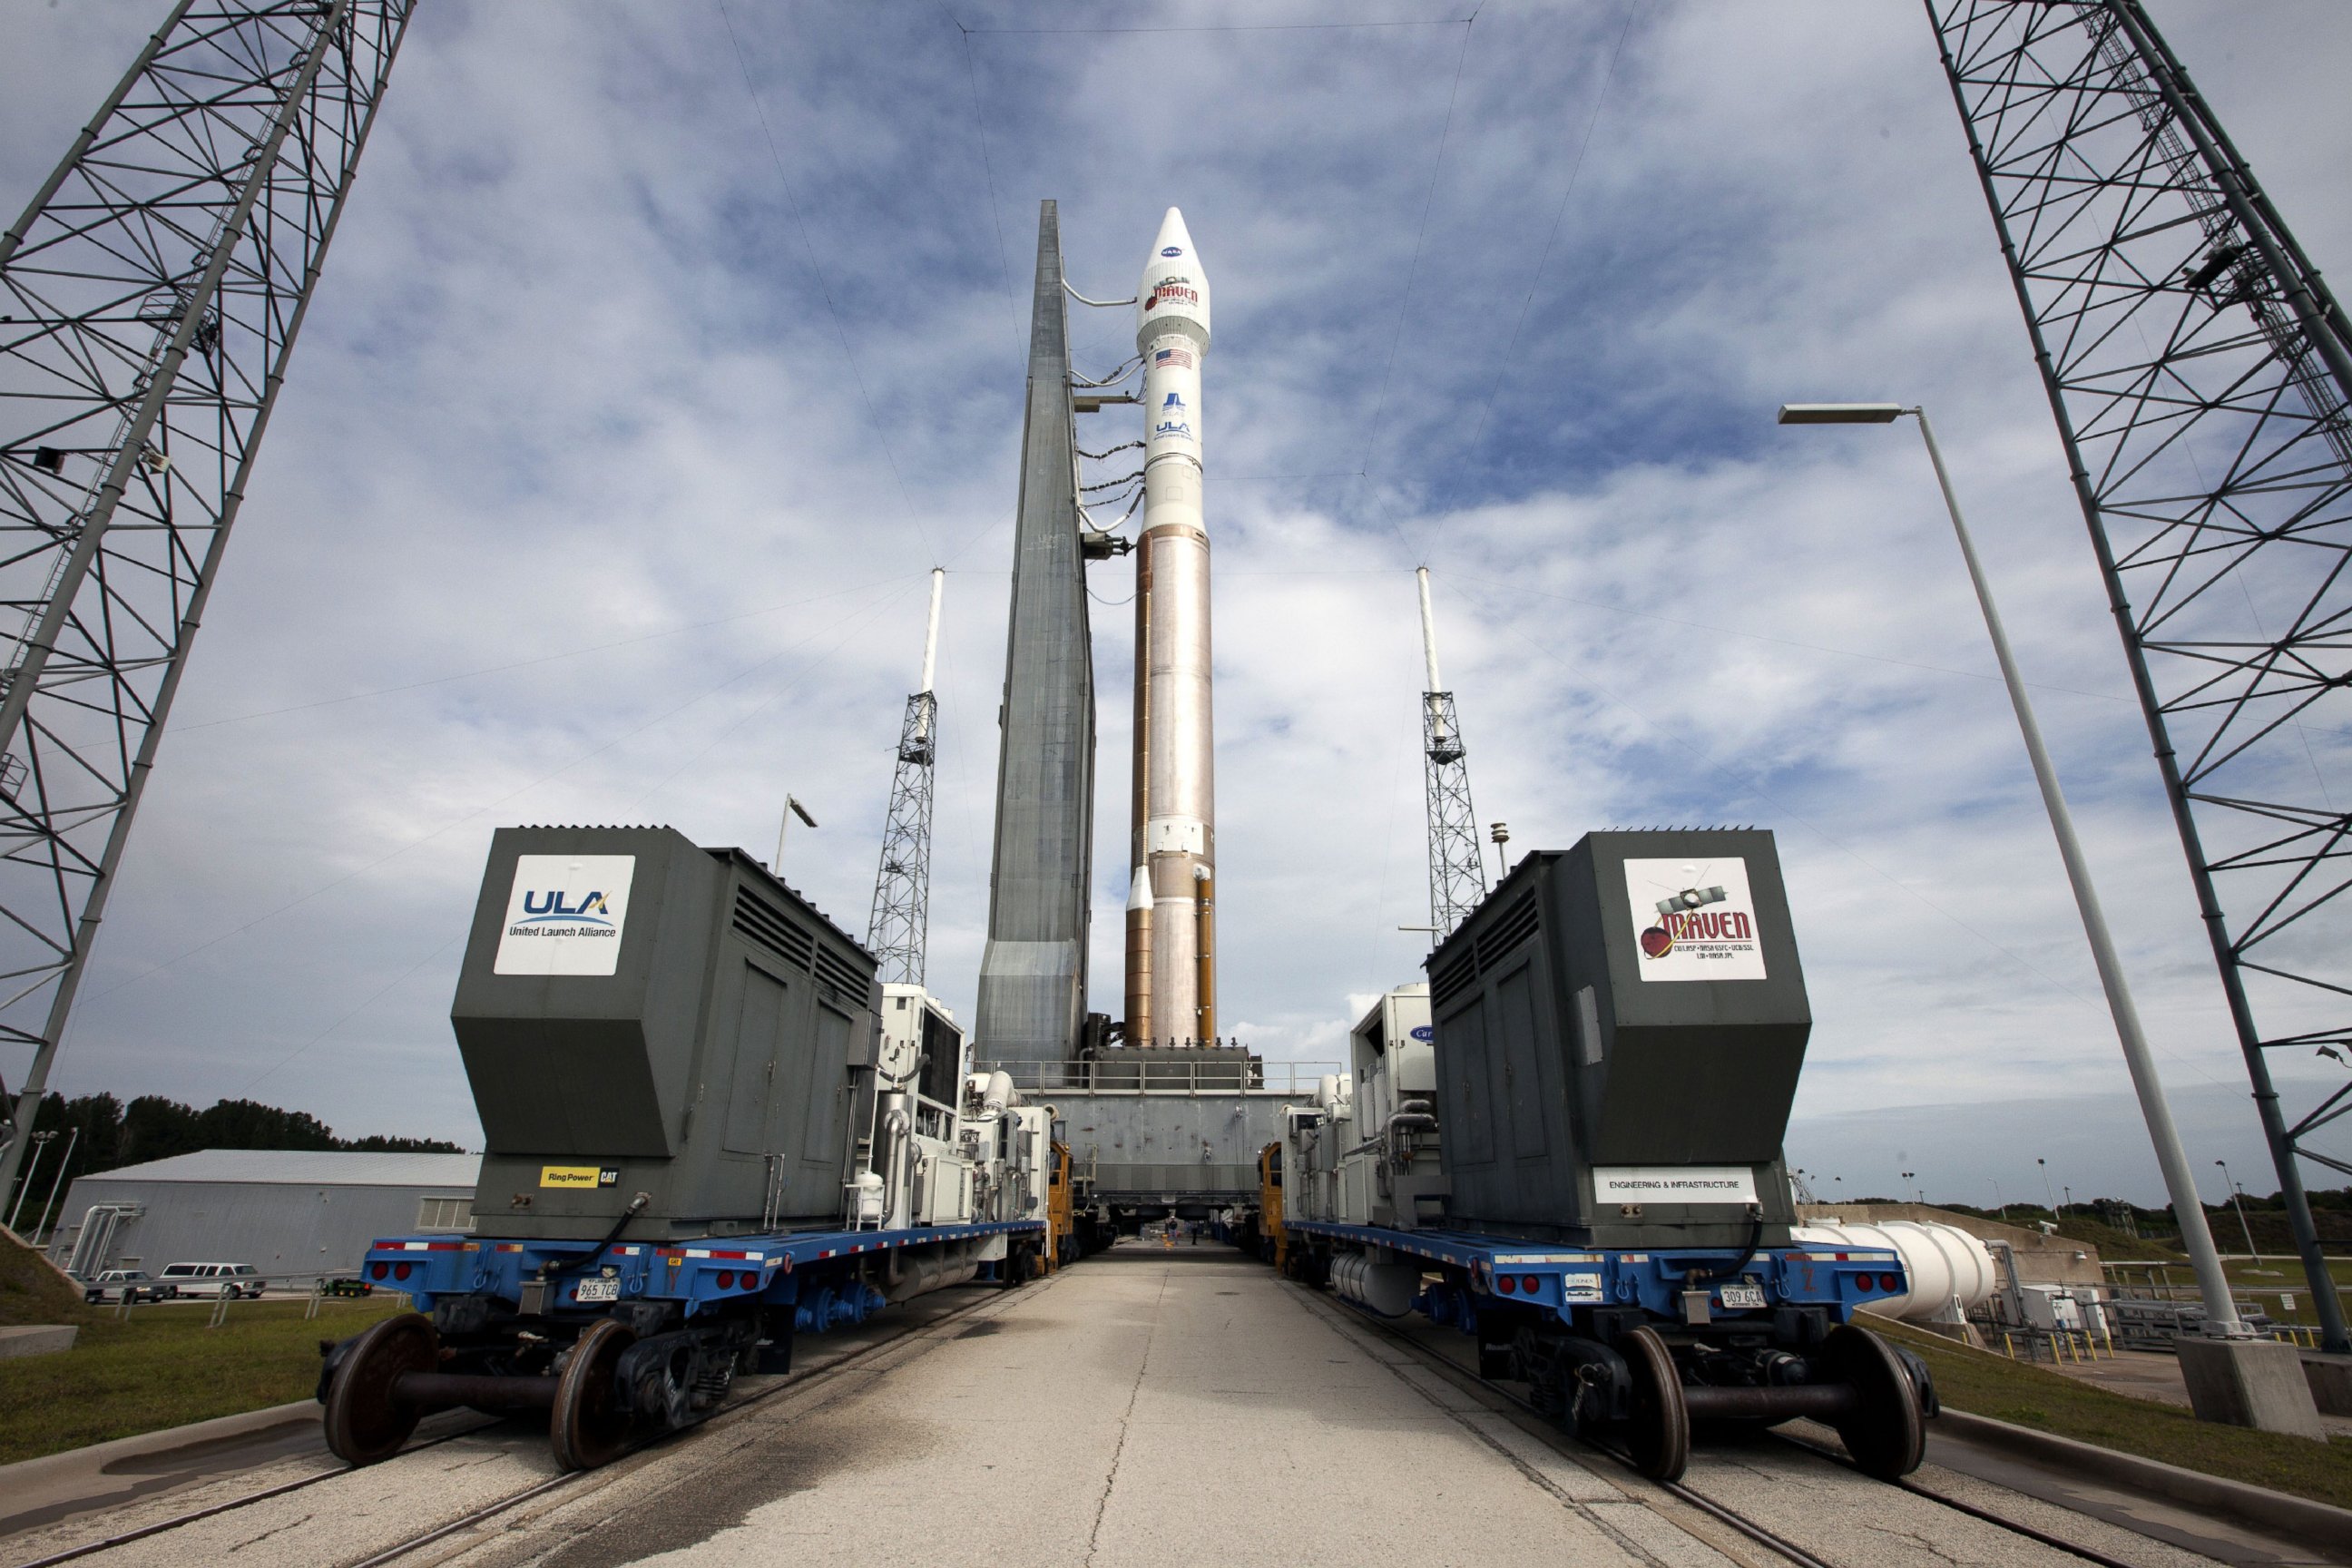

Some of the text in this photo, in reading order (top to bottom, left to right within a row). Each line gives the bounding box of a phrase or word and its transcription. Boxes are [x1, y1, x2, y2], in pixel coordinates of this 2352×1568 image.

[1155, 285, 1198, 302] MAVEN
[1156, 421, 1191, 432] ULA
[524, 890, 611, 915] ULA
[1661, 911, 1751, 939] MAVEN
[509, 926, 616, 937] United Launch Alliance
[548, 1173, 593, 1182] Ring Power
[601, 1171, 618, 1183] CAT
[1610, 1181, 1661, 1189] ENGINEERING
[1671, 1181, 1740, 1189] INFRASTRUCTURE
[581, 1285, 598, 1296] 965
[1724, 1290, 1762, 1302] 309 6CA
